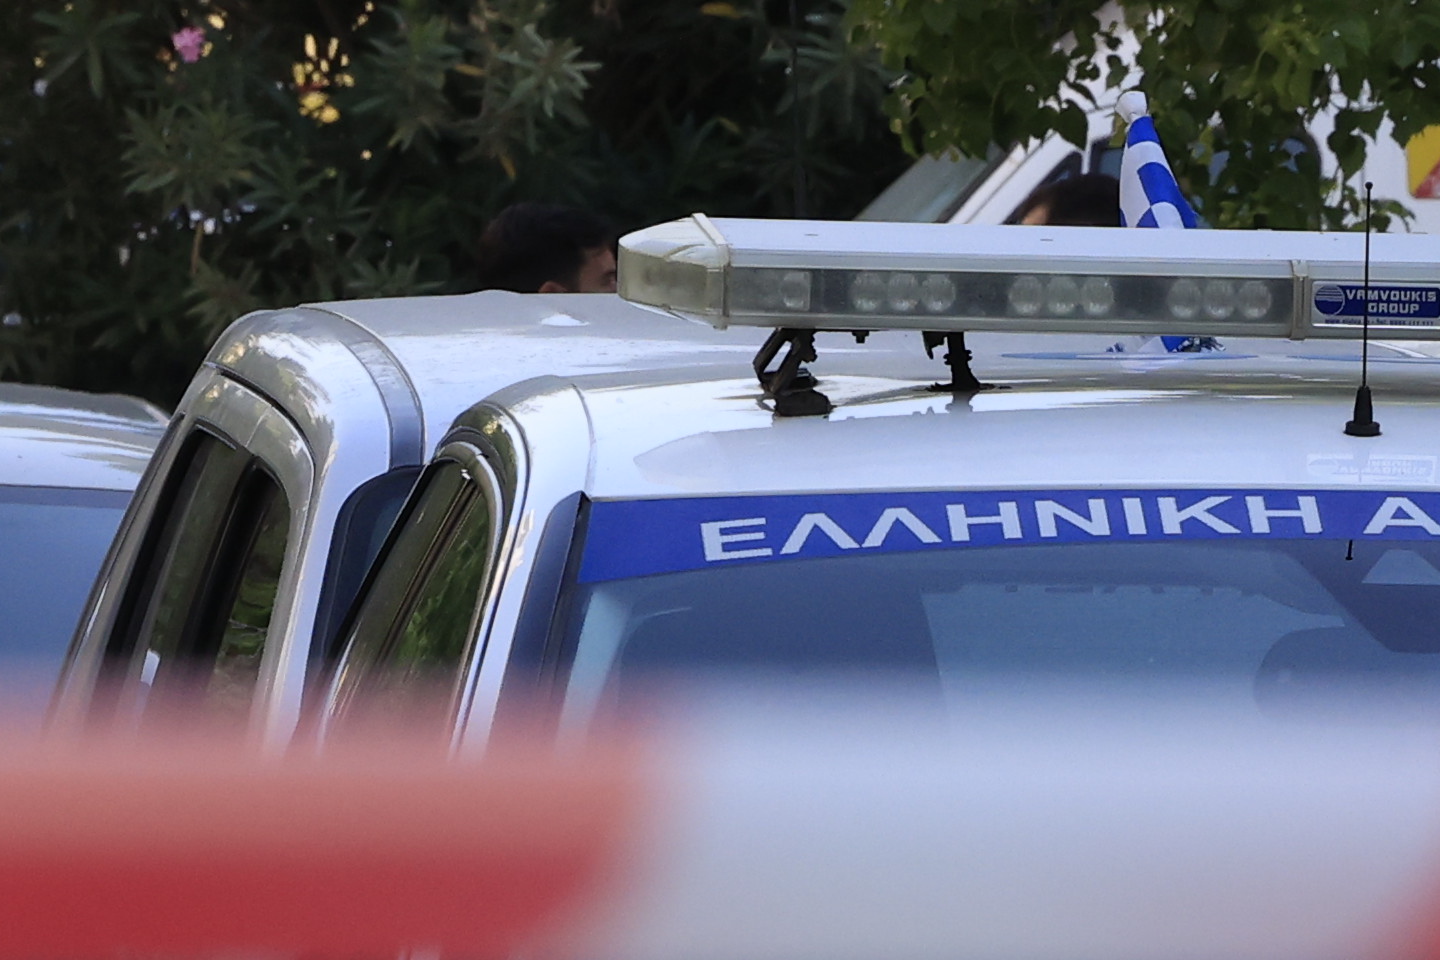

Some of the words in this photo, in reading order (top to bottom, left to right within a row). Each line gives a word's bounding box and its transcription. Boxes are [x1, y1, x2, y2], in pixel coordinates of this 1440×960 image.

[1346, 289, 1437, 302] VAMVOUKIS
[1368, 303, 1420, 314] GROUP
[700, 496, 1323, 562] ΕΛΛΗΝΙΚΗ
